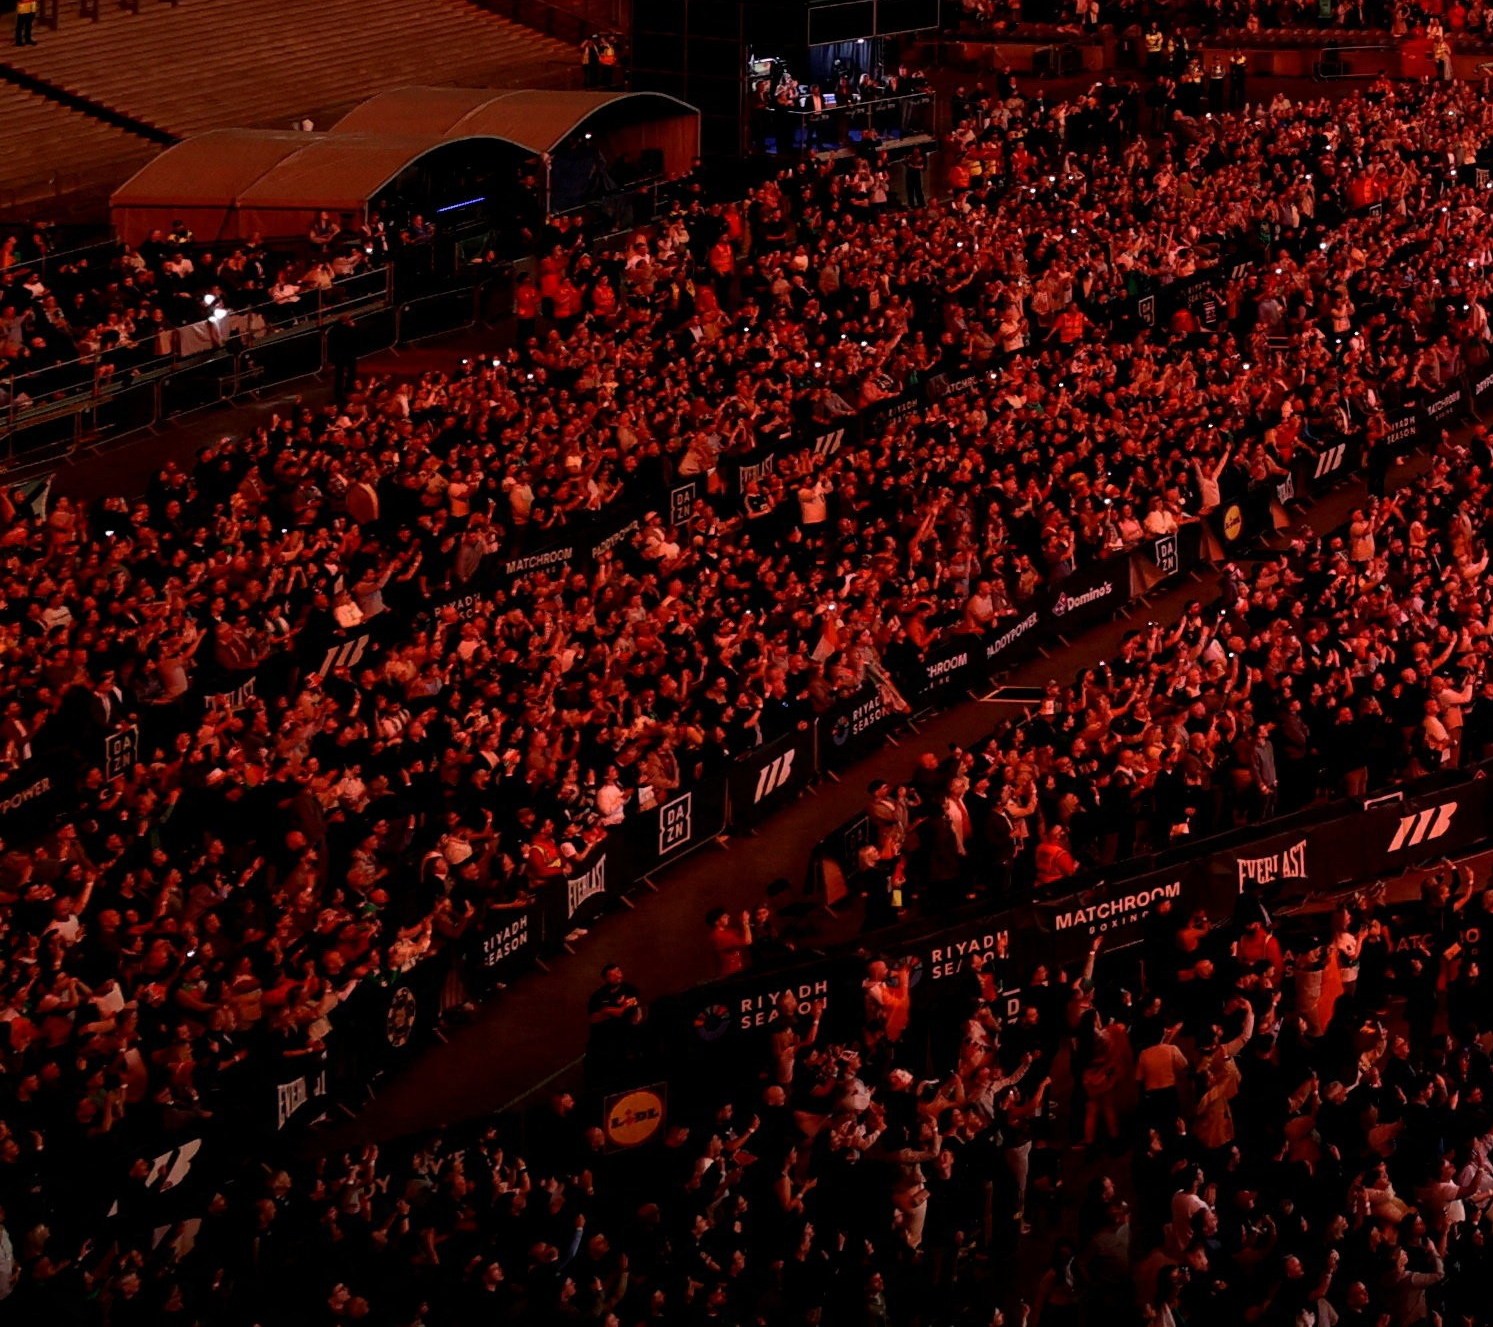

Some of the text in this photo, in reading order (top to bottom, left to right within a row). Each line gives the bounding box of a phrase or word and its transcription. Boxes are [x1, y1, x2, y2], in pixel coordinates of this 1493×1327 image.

[677, 493, 691, 506] DA
[677, 505, 691, 520] ZN
[1161, 542, 1174, 558] DA
[506, 547, 573, 575] MATCHROOM
[1161, 556, 1175, 572] ZN
[1067, 580, 1113, 612] Domino's
[113, 738, 131, 756] DA
[111, 752, 131, 776] ZN
[666, 803, 684, 824] DA
[666, 821, 684, 843] ZN
[1056, 881, 1181, 931] MATCHROOM
